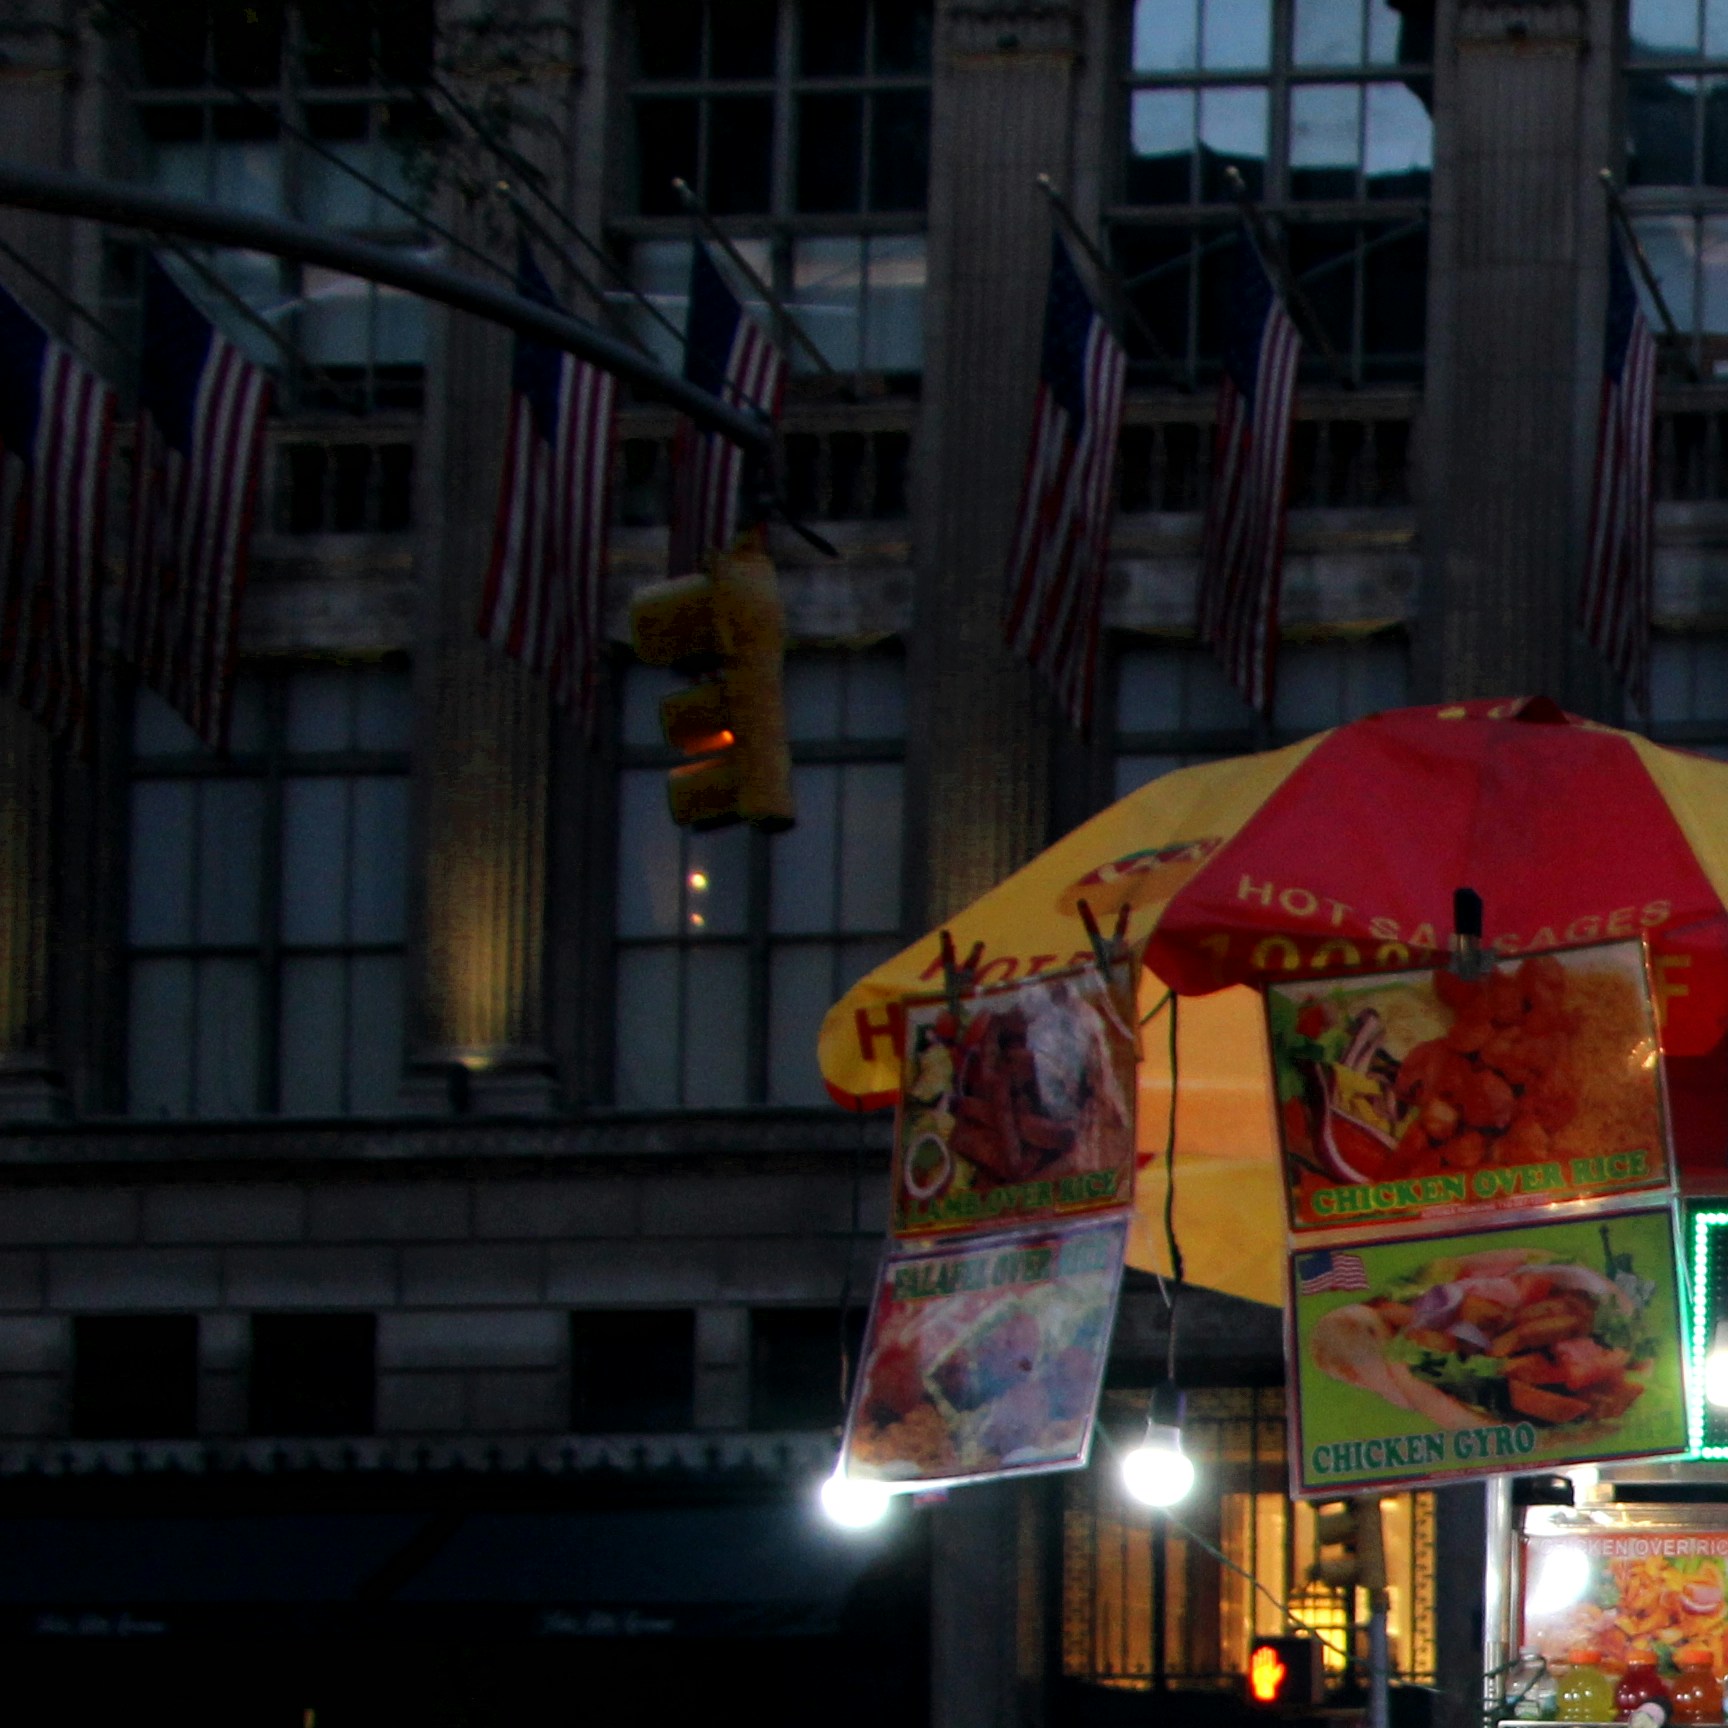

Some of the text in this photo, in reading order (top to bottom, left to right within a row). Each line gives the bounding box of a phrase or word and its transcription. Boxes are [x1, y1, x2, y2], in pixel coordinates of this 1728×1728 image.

[1237, 873, 1355, 929] HOT
[1311, 1173, 1467, 1217] CHICKEN
[1472, 1162, 1566, 1199] OVER
[1569, 1149, 1651, 1186] RICE
[1312, 1431, 1445, 1476] CHICKEN
[1453, 1422, 1537, 1460] GYRO
[1635, 1538, 1690, 1557] OVER
